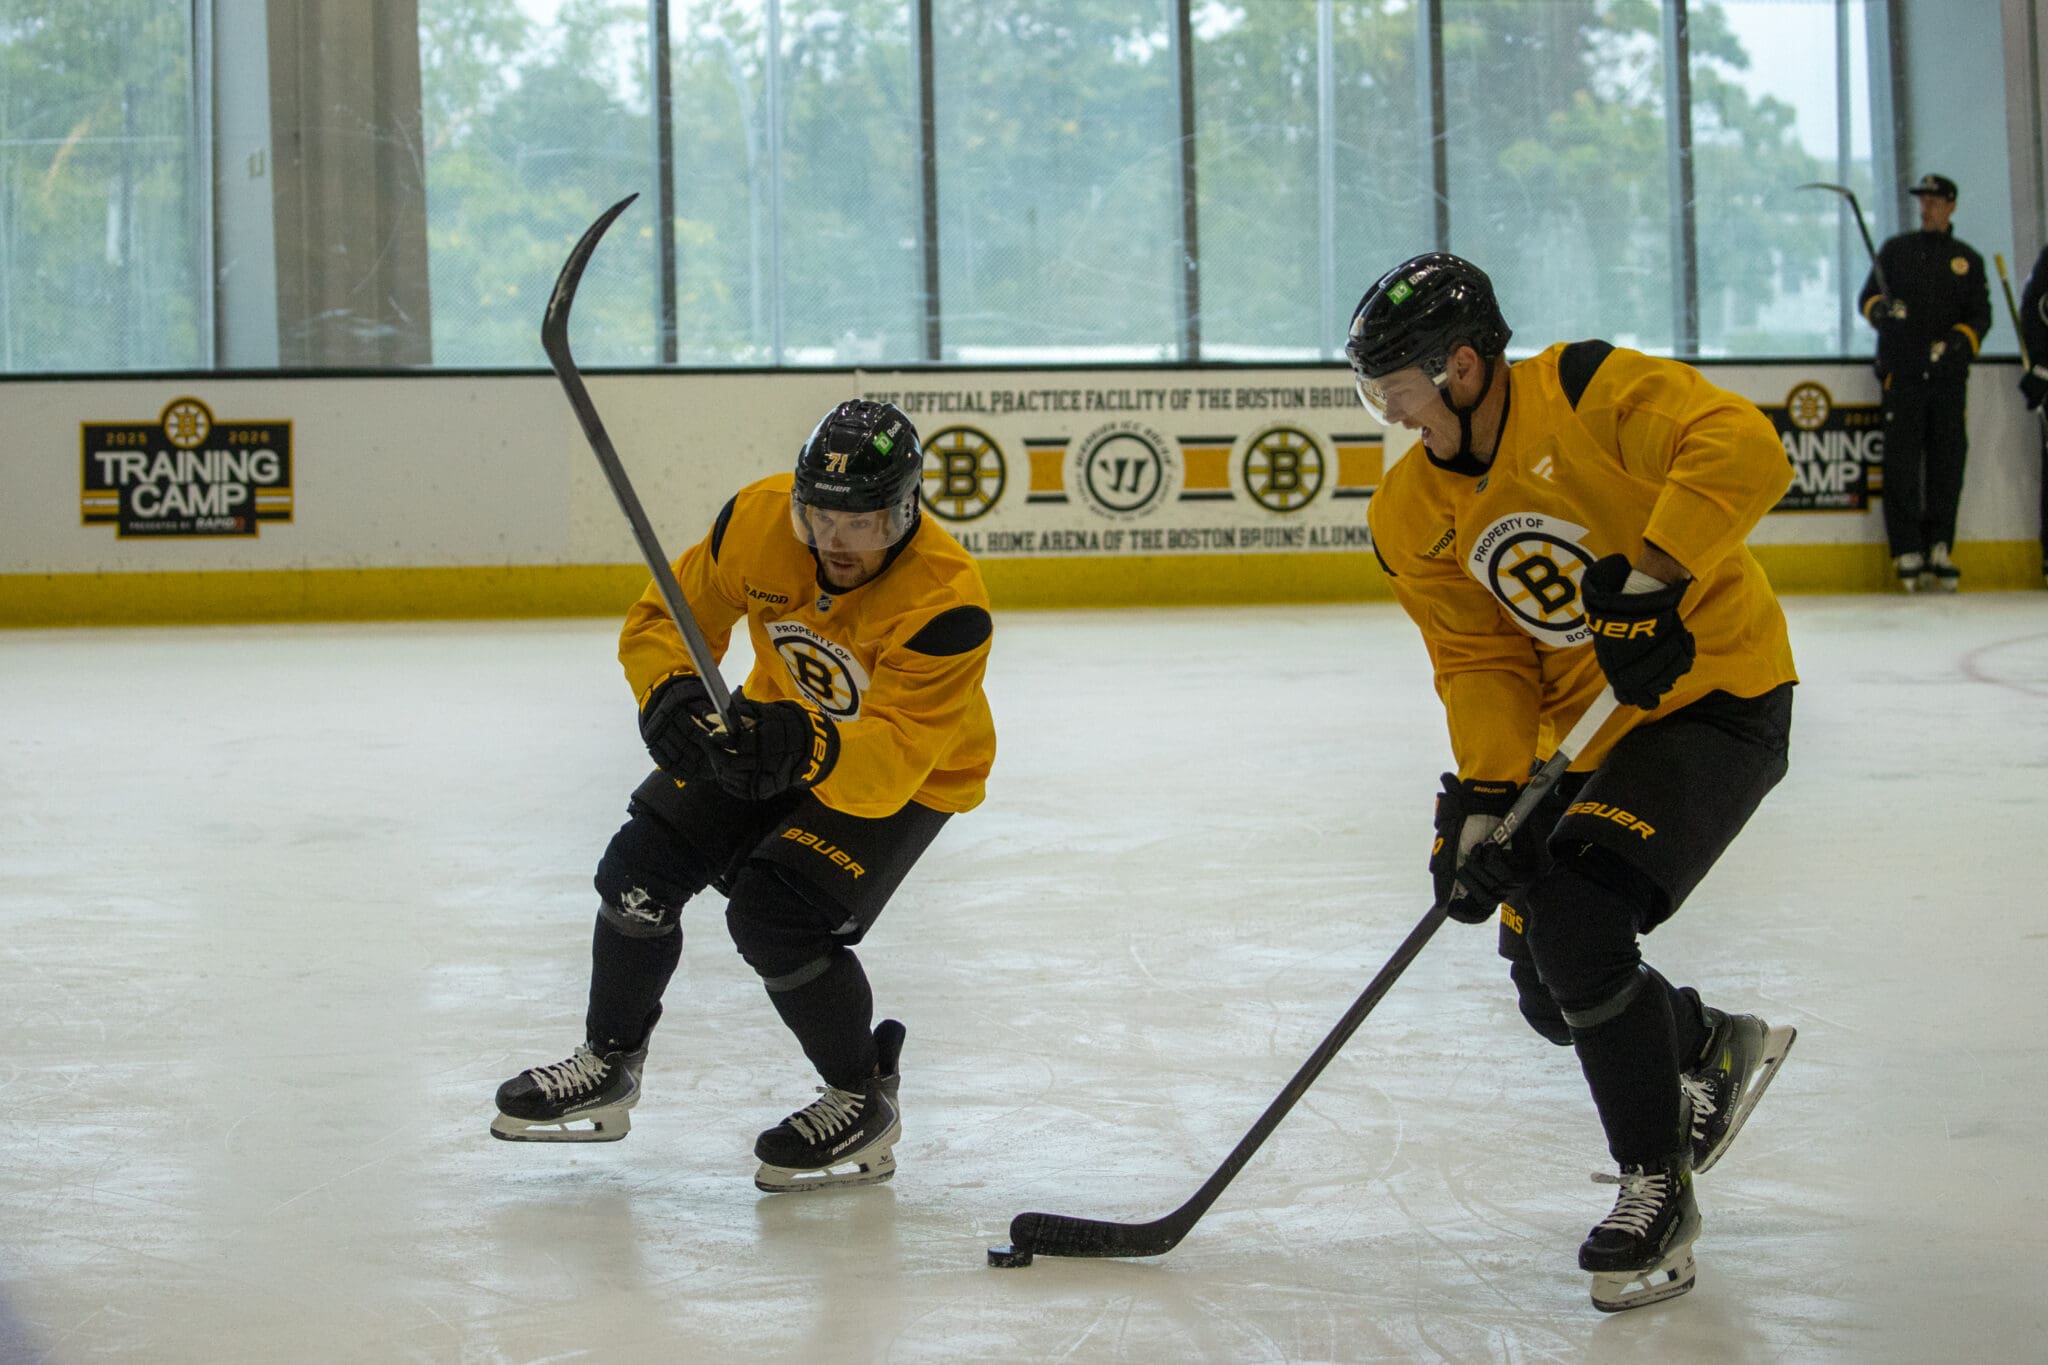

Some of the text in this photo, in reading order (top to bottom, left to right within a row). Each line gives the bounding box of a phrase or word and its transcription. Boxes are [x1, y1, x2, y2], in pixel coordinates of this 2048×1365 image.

[903, 389, 985, 413] OFFICIAL
[990, 389, 1081, 412] PRACTICE
[1084, 388, 1167, 411] FACILITY
[1170, 388, 1192, 410] OF
[1197, 388, 1232, 410] THE
[1236, 387, 1305, 409] BOSTON
[1309, 386, 1364, 409] BRUI
[825, 452, 849, 474] 71
[1781, 430, 1885, 464] AINING
[95, 450, 281, 486] TRAINING
[1793, 461, 1861, 494] AMP
[132, 482, 248, 518] CAMP
[814, 482, 851, 493] BAUER
[986, 531, 1035, 552] HOME
[1039, 530, 1099, 552] ARENA
[1102, 530, 1124, 551] OF
[1128, 529, 1164, 549] THE
[1167, 528, 1235, 549] BOSTON
[1309, 526, 1371, 546] ALUMN
[1474, 517, 1544, 563] PROPERTY OF
[1509, 554, 1577, 615] B
[1565, 627, 1594, 643] BOS
[1584, 611, 1659, 640] UER
[774, 624, 852, 663] PROPERTY OF
[793, 649, 834, 700] B
[801, 711, 828, 782] UER
[1566, 801, 1656, 840] BAUER
[780, 827, 866, 880] BAUER
[832, 1129, 865, 1156] BAUER
